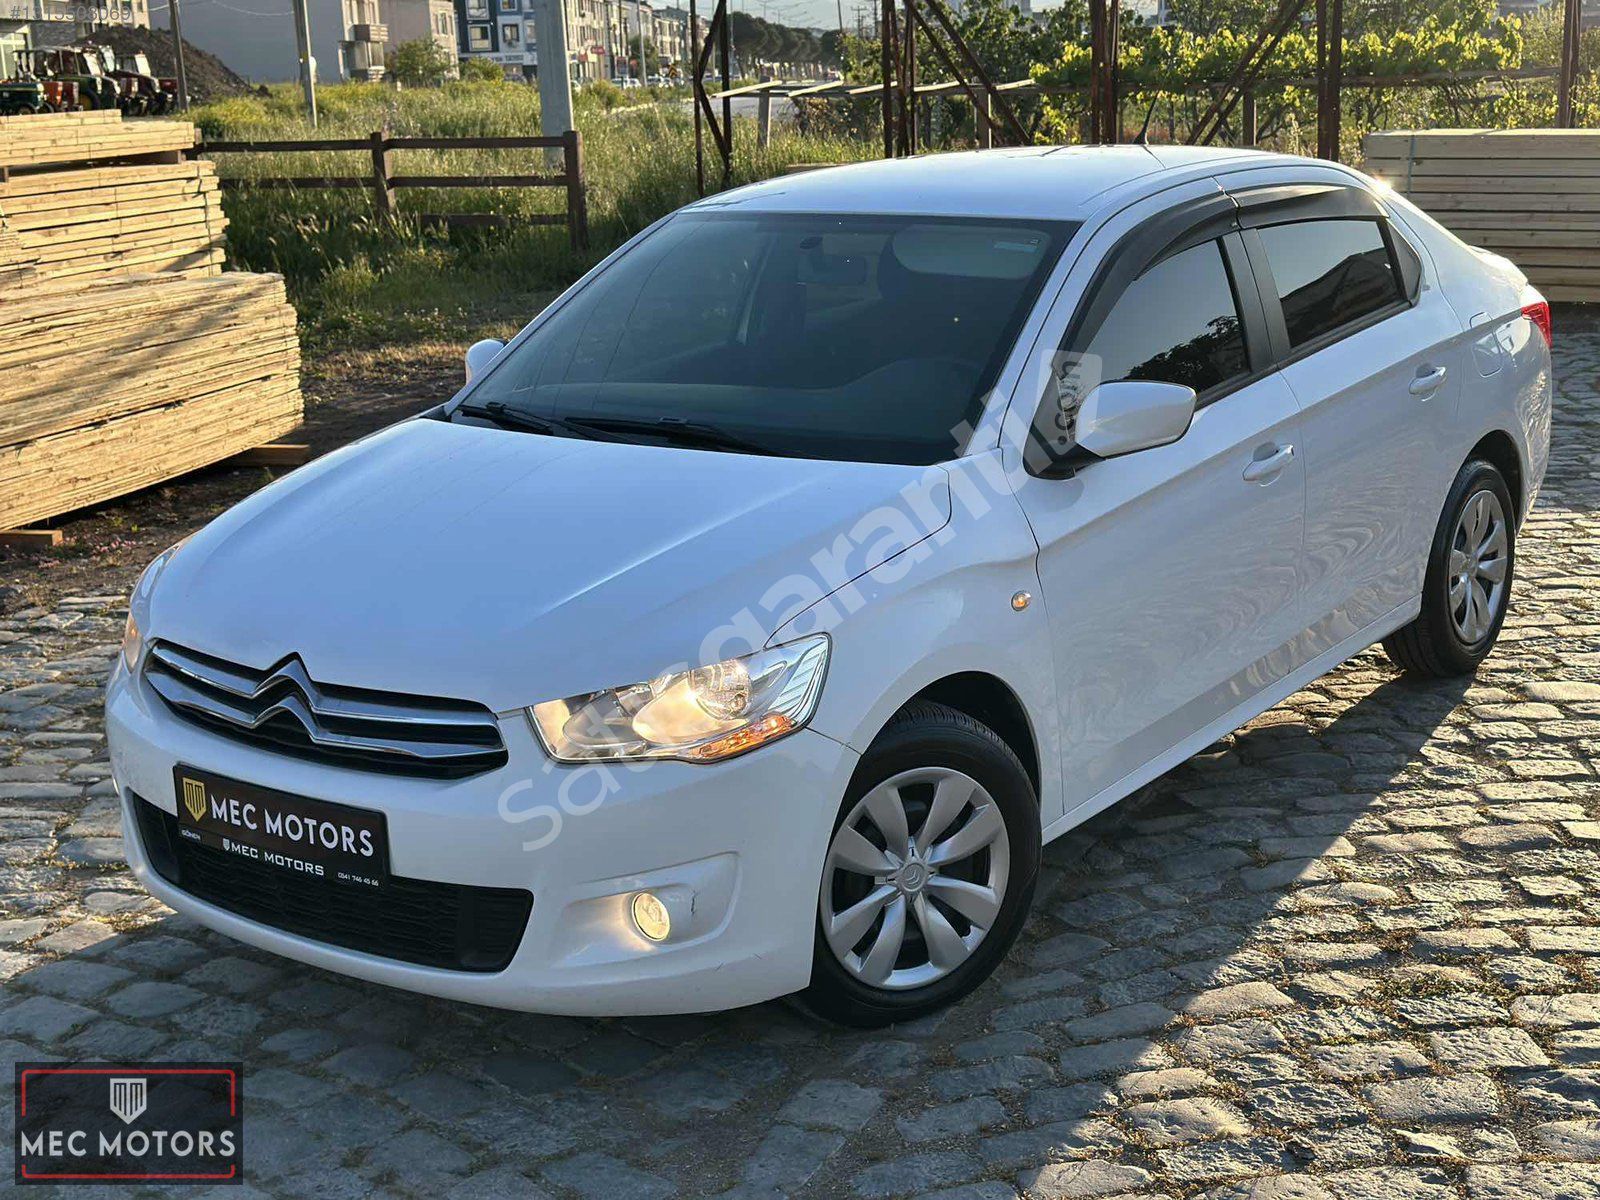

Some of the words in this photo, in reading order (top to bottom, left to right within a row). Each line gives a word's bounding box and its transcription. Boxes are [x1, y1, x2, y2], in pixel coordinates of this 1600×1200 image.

[211, 794, 257, 831] MEC
[265, 808, 374, 857] MOTORS
[232, 841, 258, 859] MEC
[264, 852, 324, 876] MOTORS
